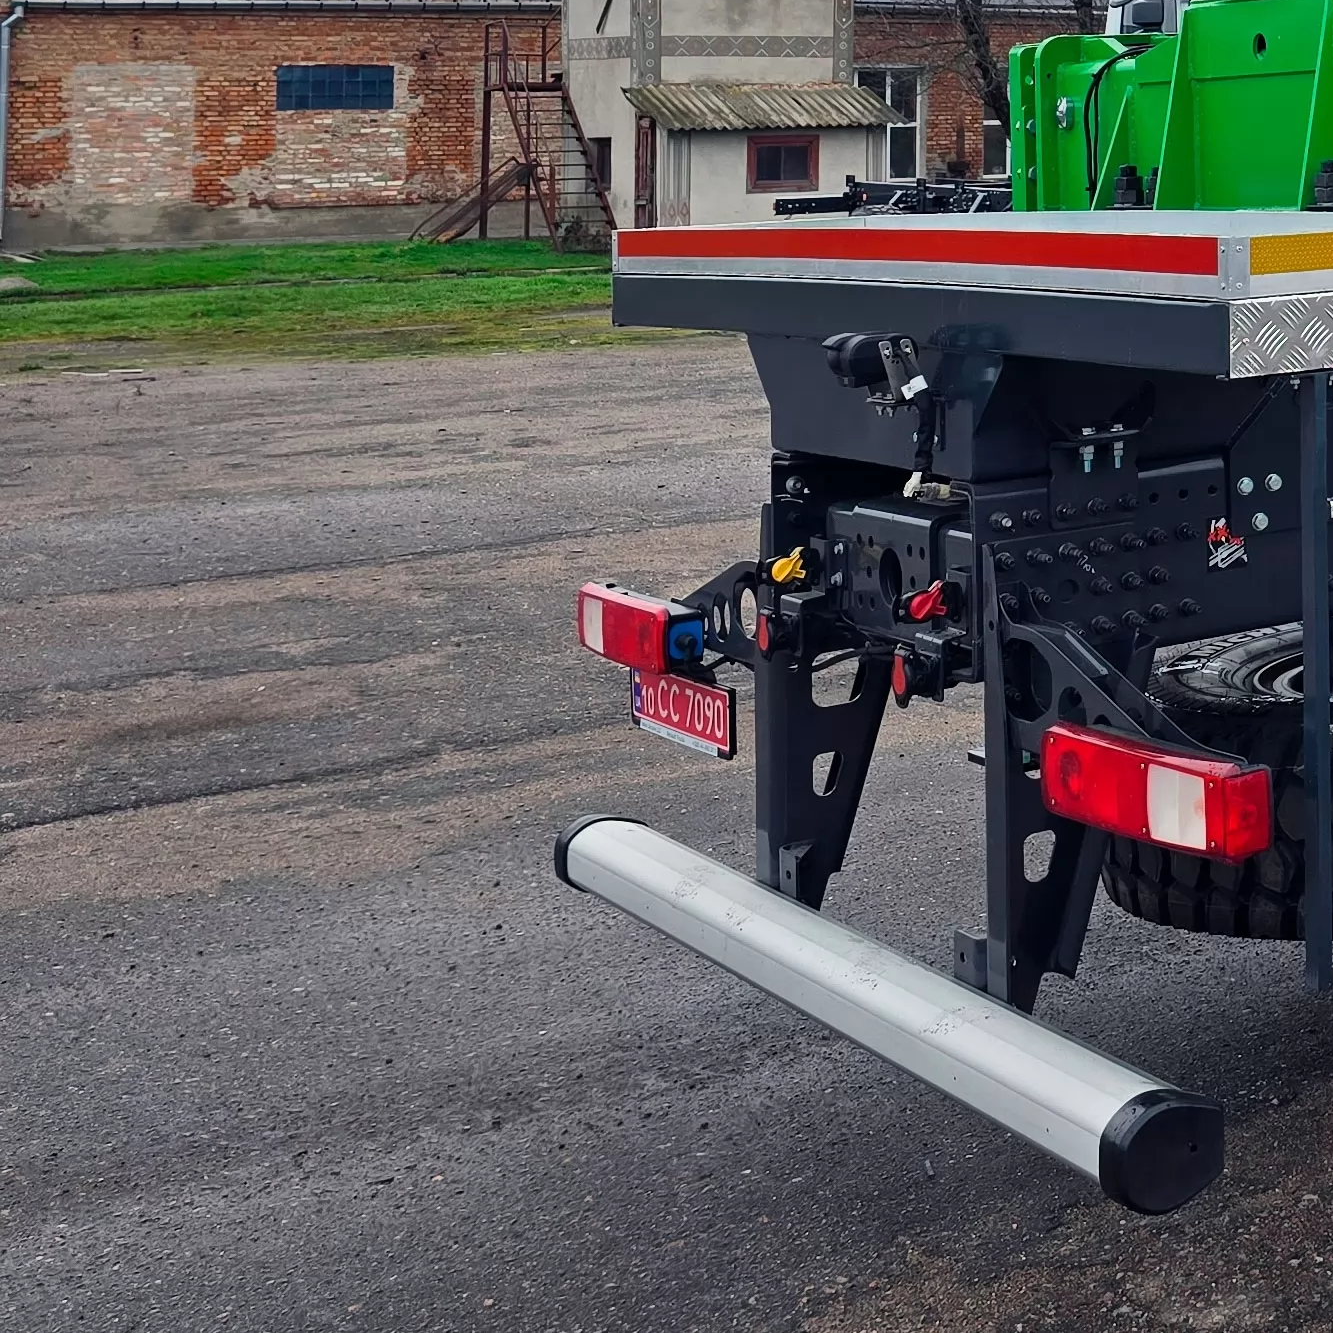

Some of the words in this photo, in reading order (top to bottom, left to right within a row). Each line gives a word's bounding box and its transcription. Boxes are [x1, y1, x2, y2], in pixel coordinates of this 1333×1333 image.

[641, 684, 655, 716] 10
[657, 678, 680, 723] CC
[685, 687, 724, 739] 7090
